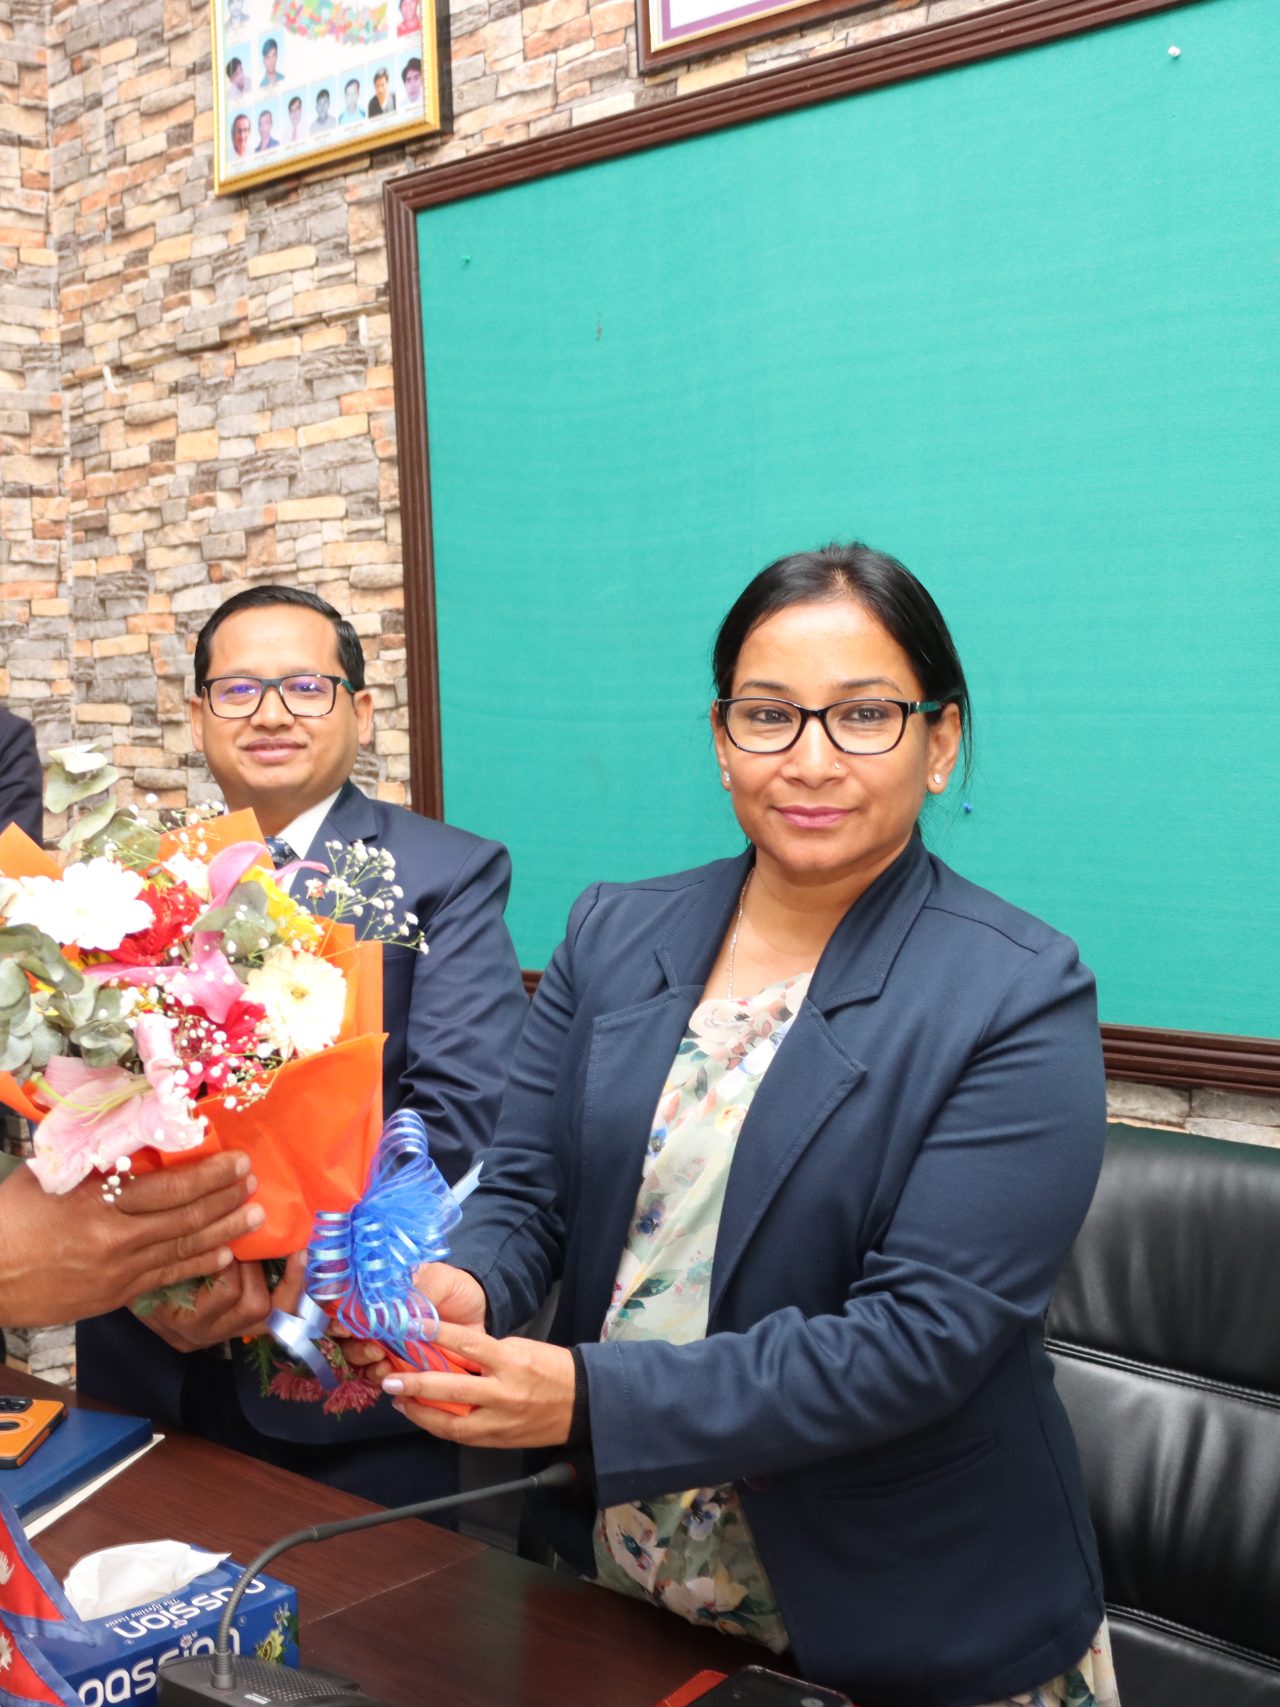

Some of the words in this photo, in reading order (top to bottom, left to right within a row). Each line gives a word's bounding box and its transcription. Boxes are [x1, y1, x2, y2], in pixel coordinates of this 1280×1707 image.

[163, 1599, 180, 1607] The
[131, 1603, 163, 1618] lifetime
[105, 1615, 130, 1628] tissue
